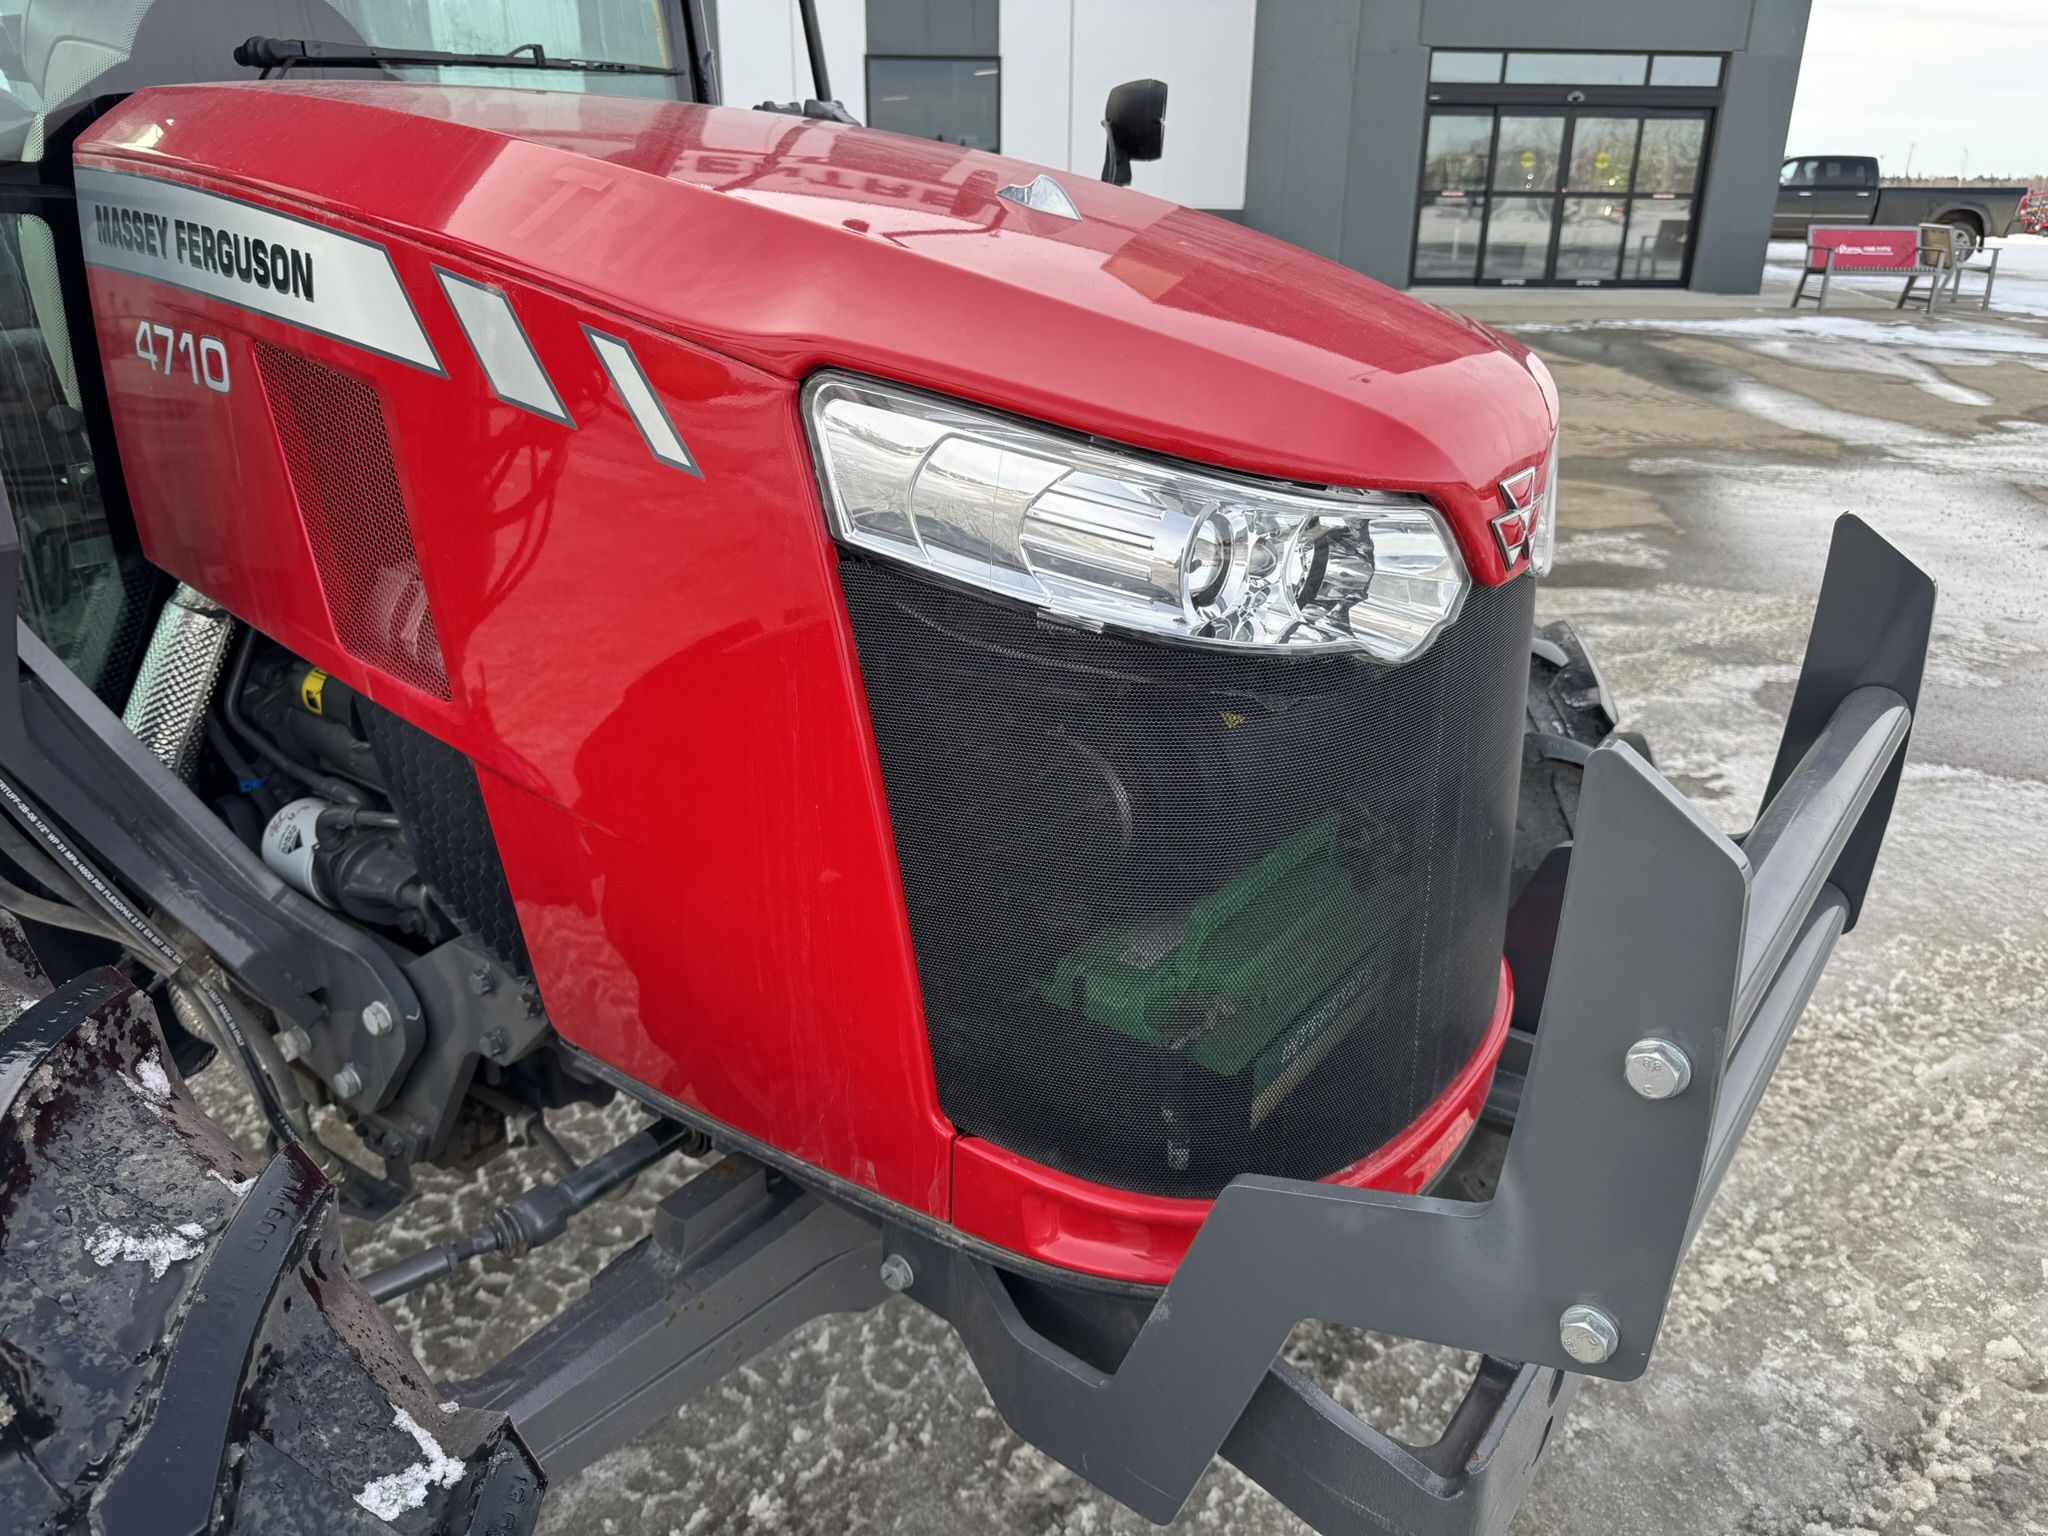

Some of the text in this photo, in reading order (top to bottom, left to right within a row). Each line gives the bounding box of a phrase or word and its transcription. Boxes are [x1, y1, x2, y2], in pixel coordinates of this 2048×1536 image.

[95, 205, 315, 303] MASSEY FERGUSON
[135, 320, 231, 394] 4710
[47, 832, 60, 845] WP
[102, 888, 134, 920] FLEXOPAK
[218, 1003, 232, 1023] MADE
[232, 1028, 245, 1047] ITALY
